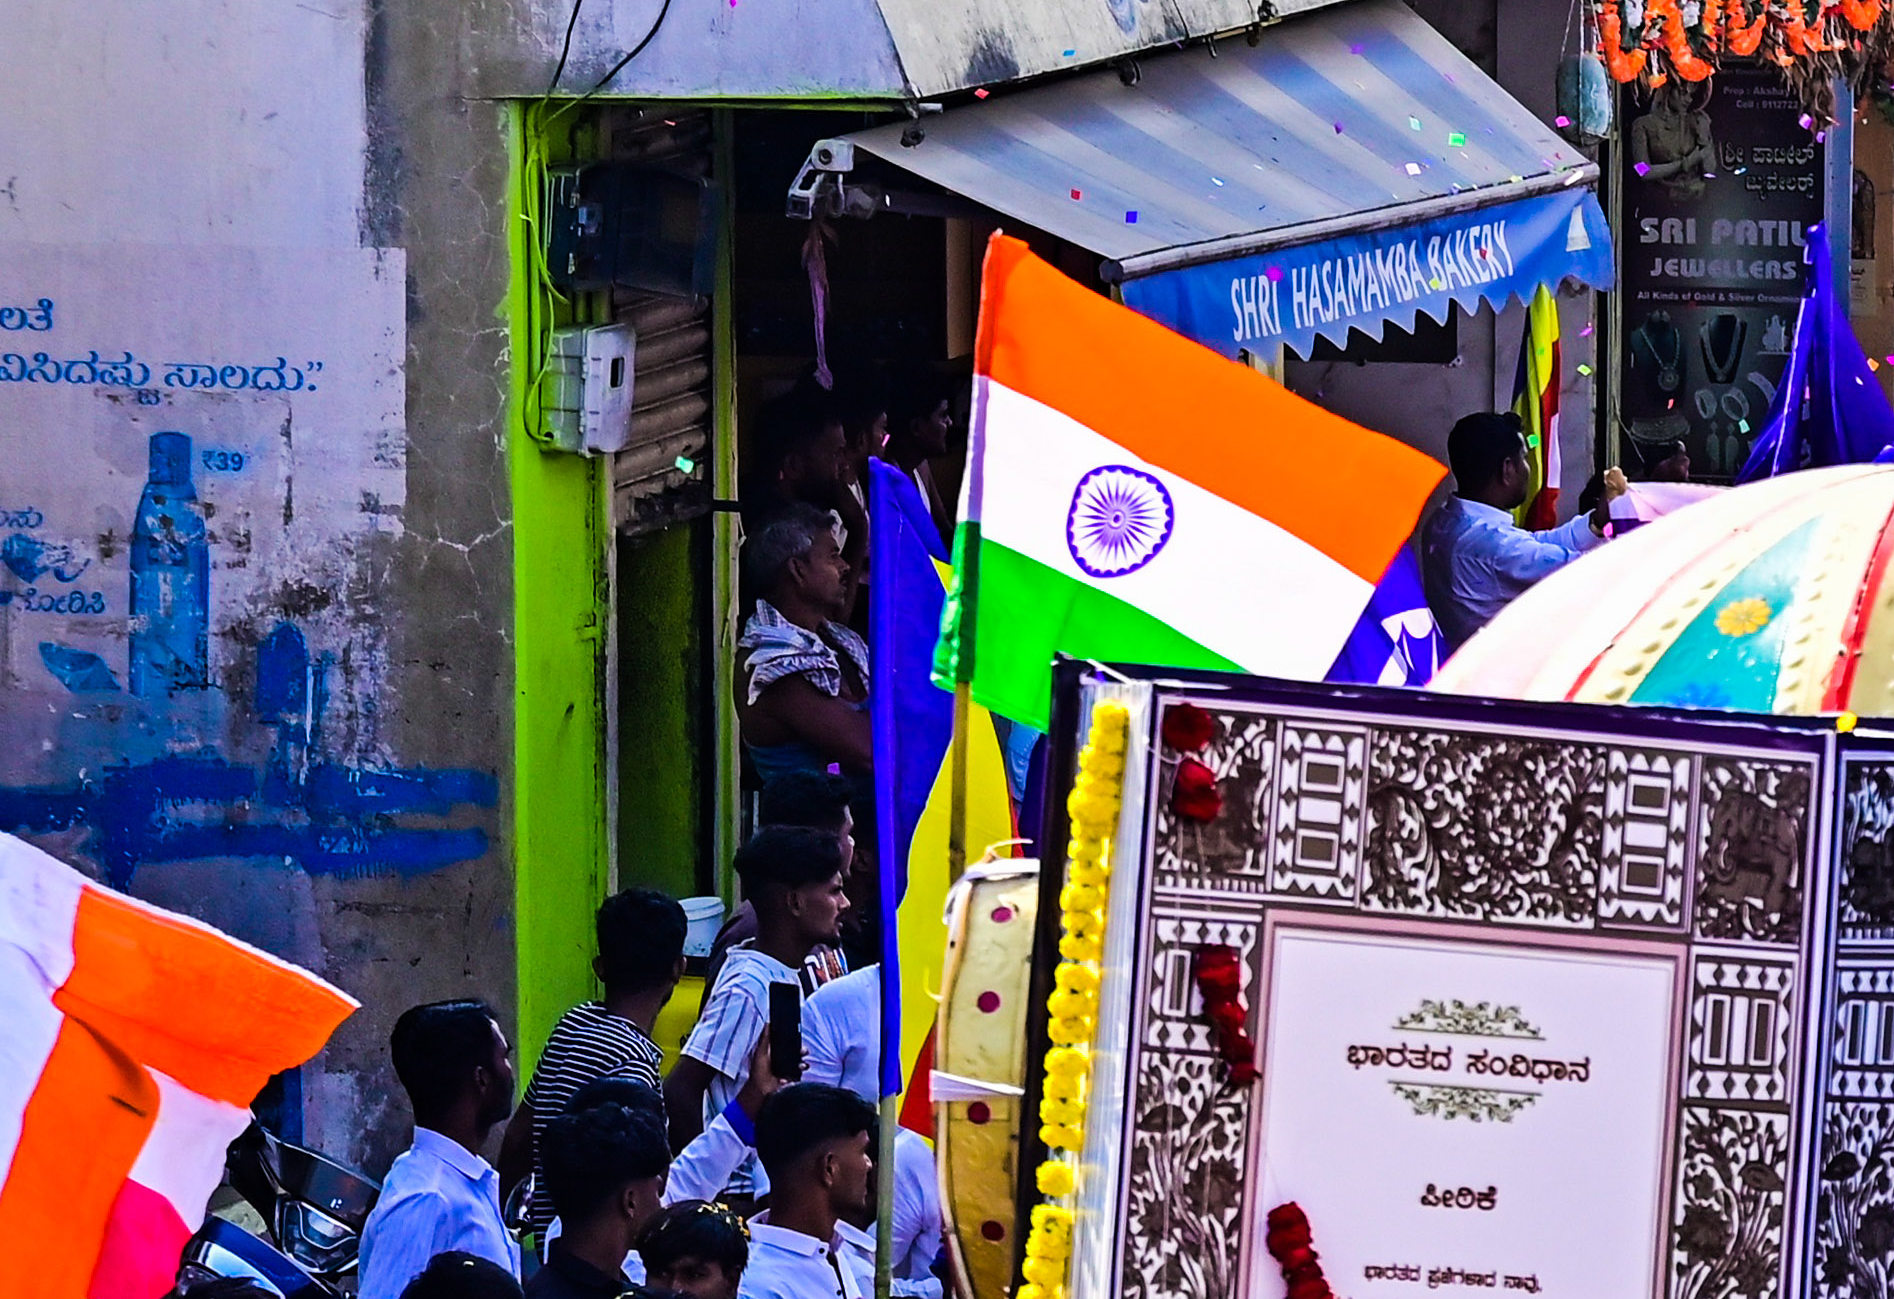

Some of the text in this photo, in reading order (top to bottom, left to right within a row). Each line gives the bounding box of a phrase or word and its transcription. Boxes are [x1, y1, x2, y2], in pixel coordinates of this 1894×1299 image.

[1639, 217, 1808, 248] SRI PATIL
[1230, 220, 1514, 342] SHRI HASAMAMBA BAKERY
[1649, 257, 1798, 280] JEWELLERS
[1347, 1042, 1591, 1085] ಭಾರತದ ಸಂವಿಧಾನ
[1420, 1183, 1497, 1211] ಪೀಠಿಕೆ
[1364, 1263, 1422, 1282] ಭಾರತದ
